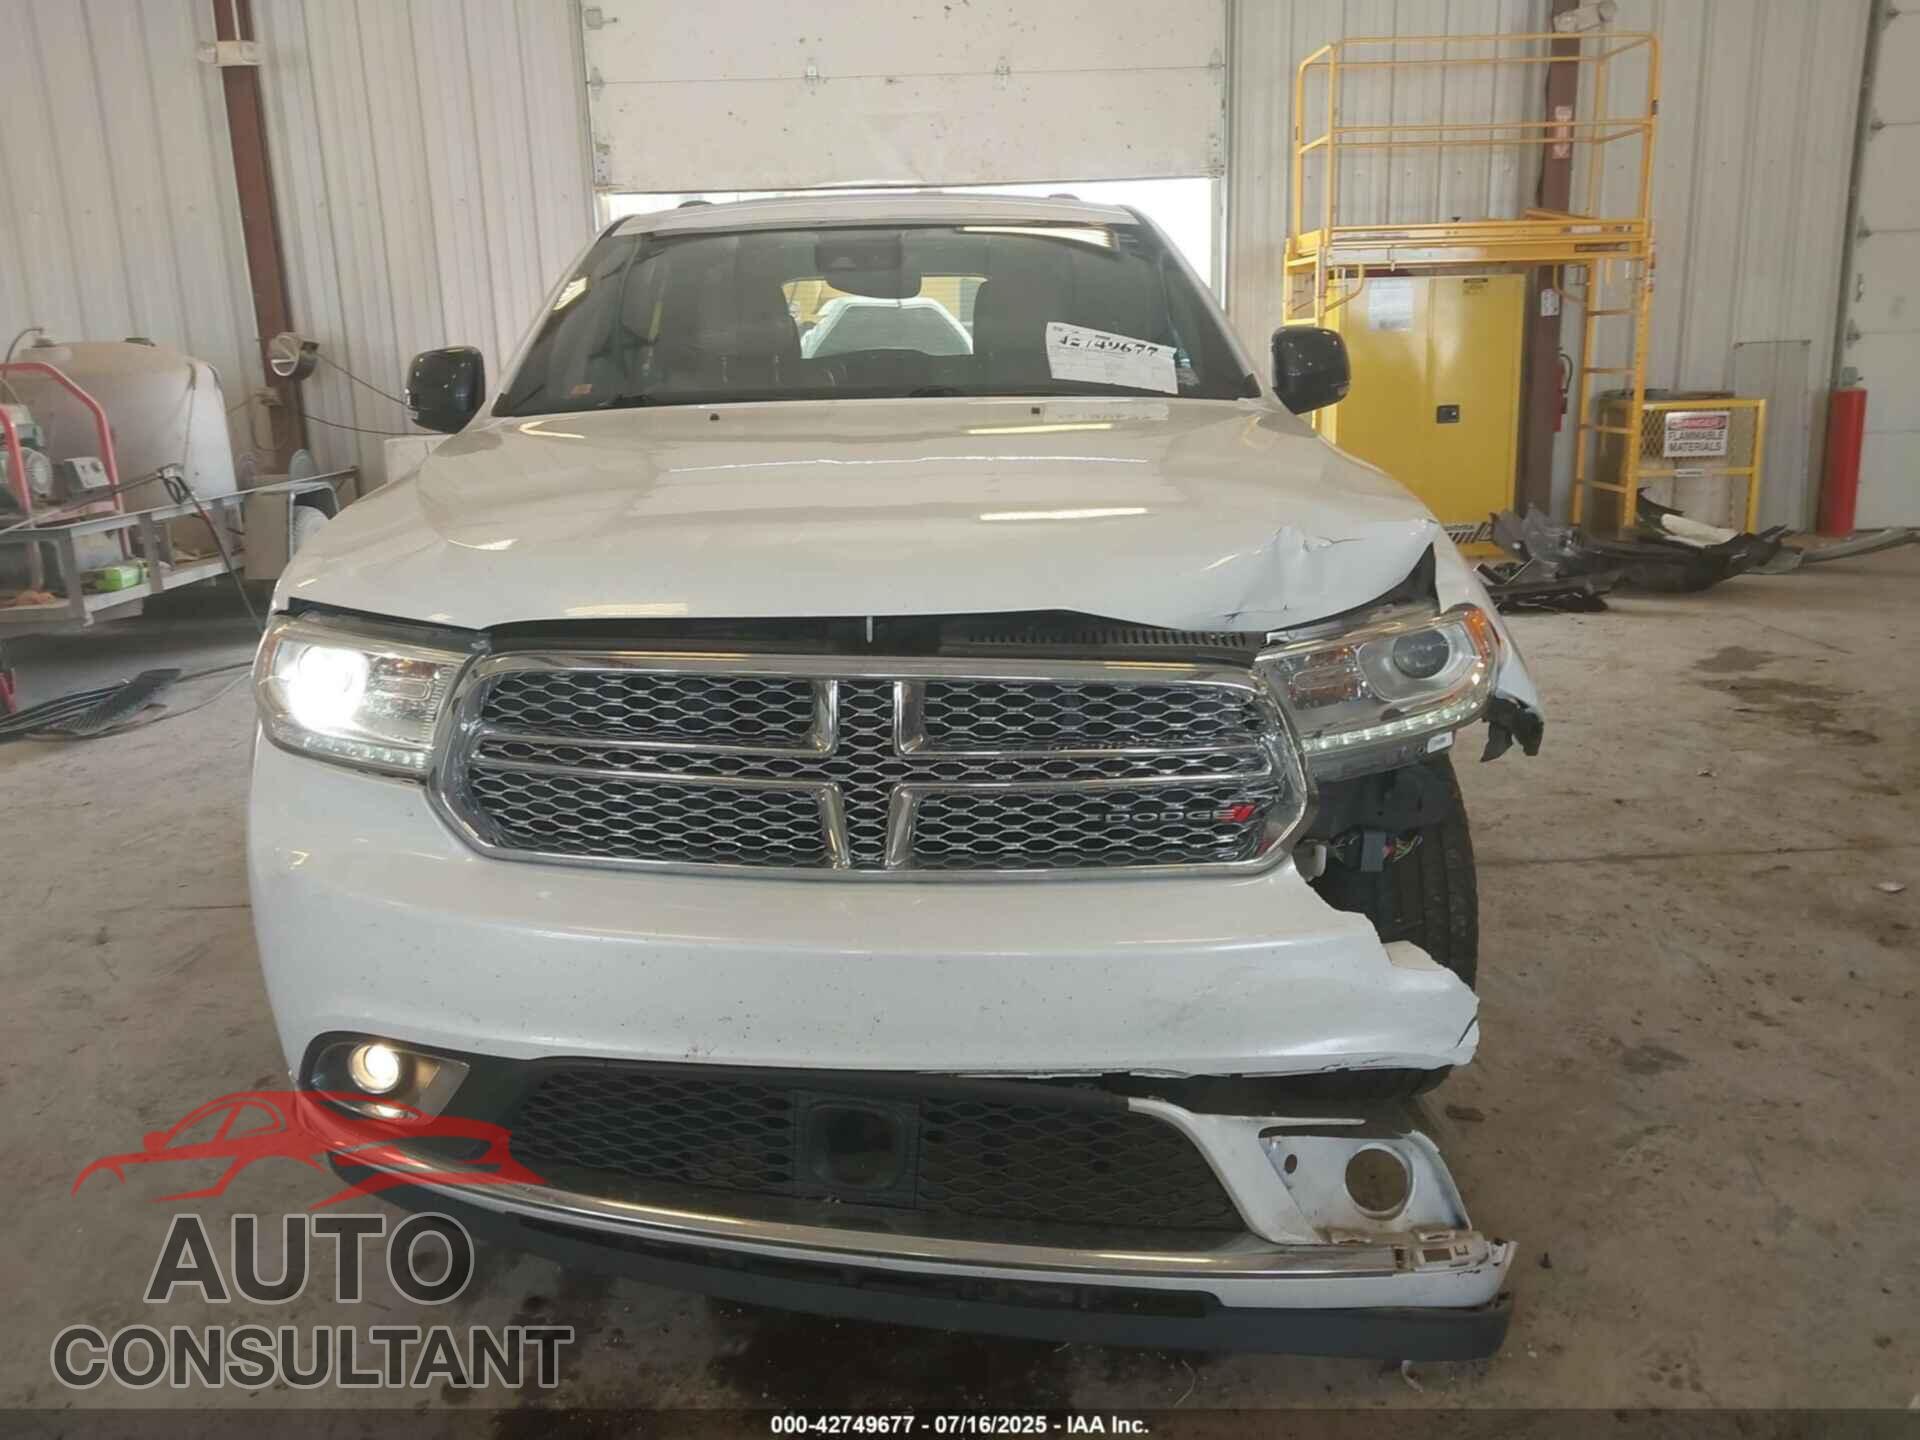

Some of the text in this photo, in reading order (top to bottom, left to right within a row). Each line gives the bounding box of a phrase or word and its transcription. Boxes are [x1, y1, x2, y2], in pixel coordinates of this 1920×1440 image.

[1668, 431, 1724, 441] FLAMMABLE
[1670, 442, 1722, 452] MATERIALS
[1105, 810, 1235, 823] DODGE
